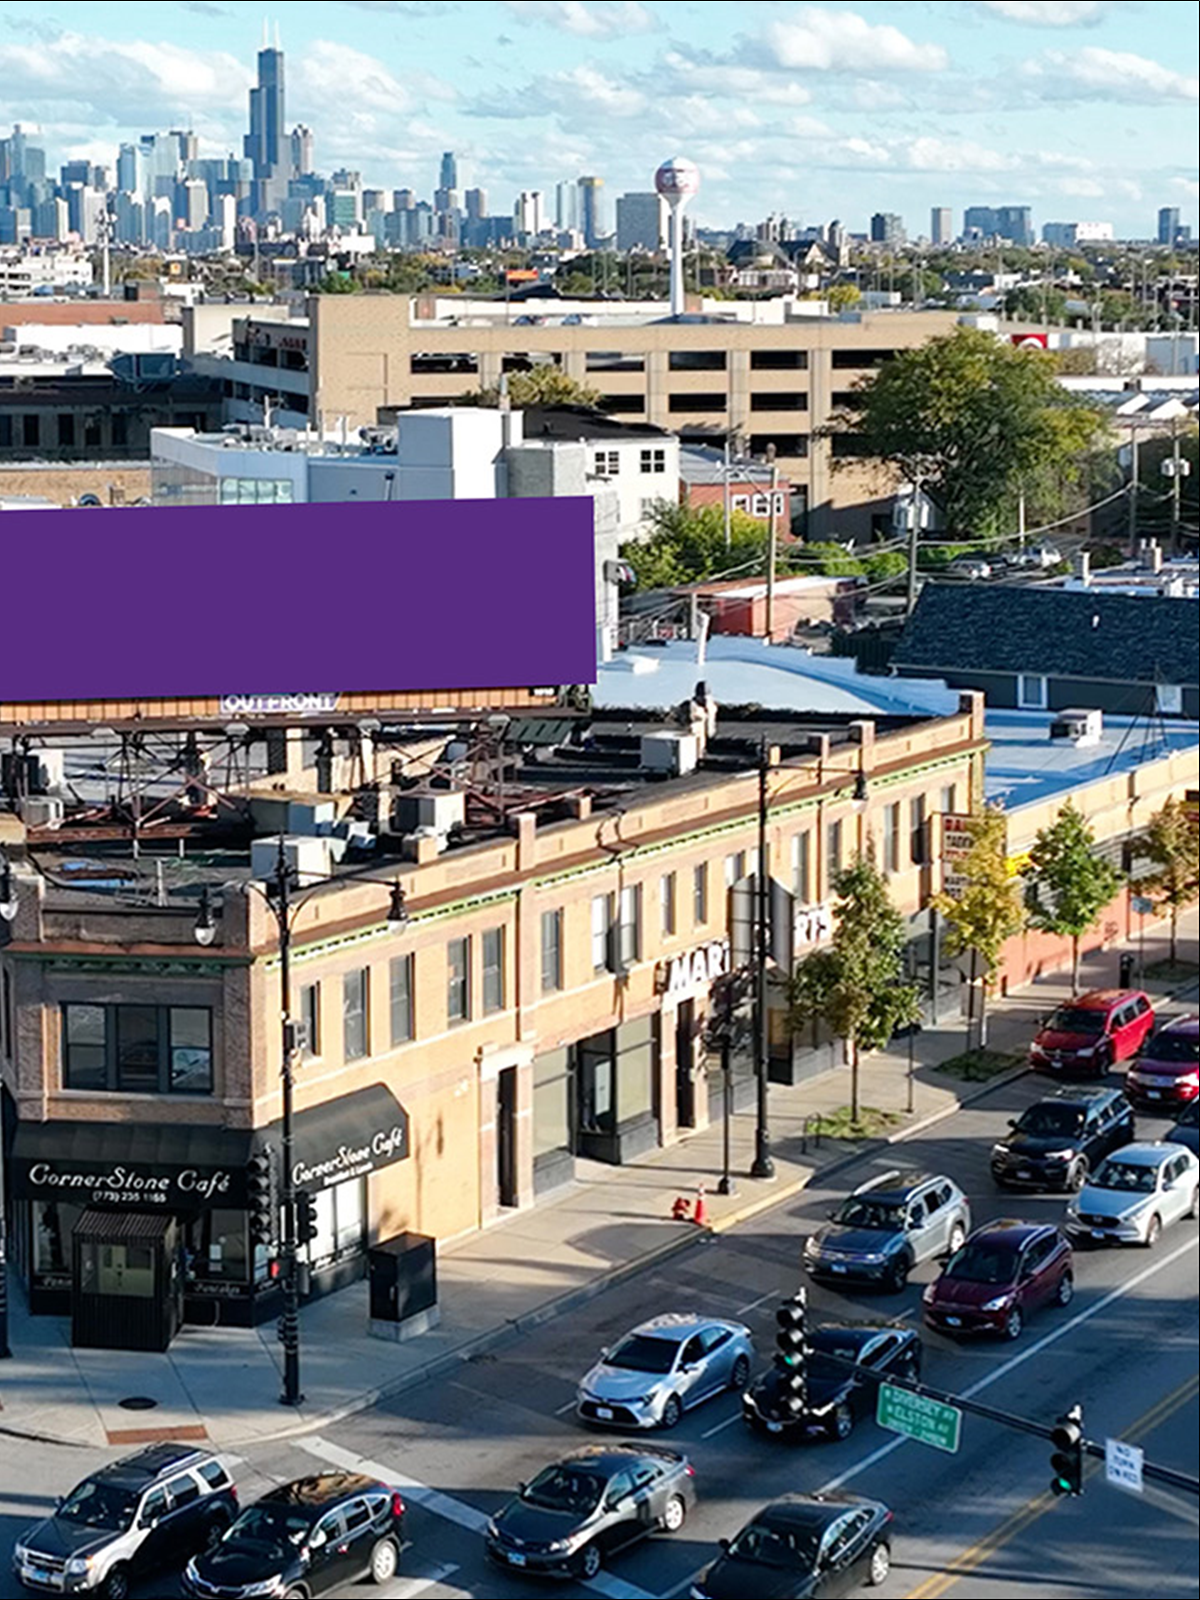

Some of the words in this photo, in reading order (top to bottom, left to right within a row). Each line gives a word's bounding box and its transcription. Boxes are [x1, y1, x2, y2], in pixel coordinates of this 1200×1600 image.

[224, 693, 336, 711] OUTFRONT
[290, 1146, 371, 1186] CornerStone
[372, 1127, 403, 1158] Café
[28, 1162, 171, 1189] CornerStone
[177, 1168, 231, 1199] Café
[893, 1405, 936, 1431] ELSTON
